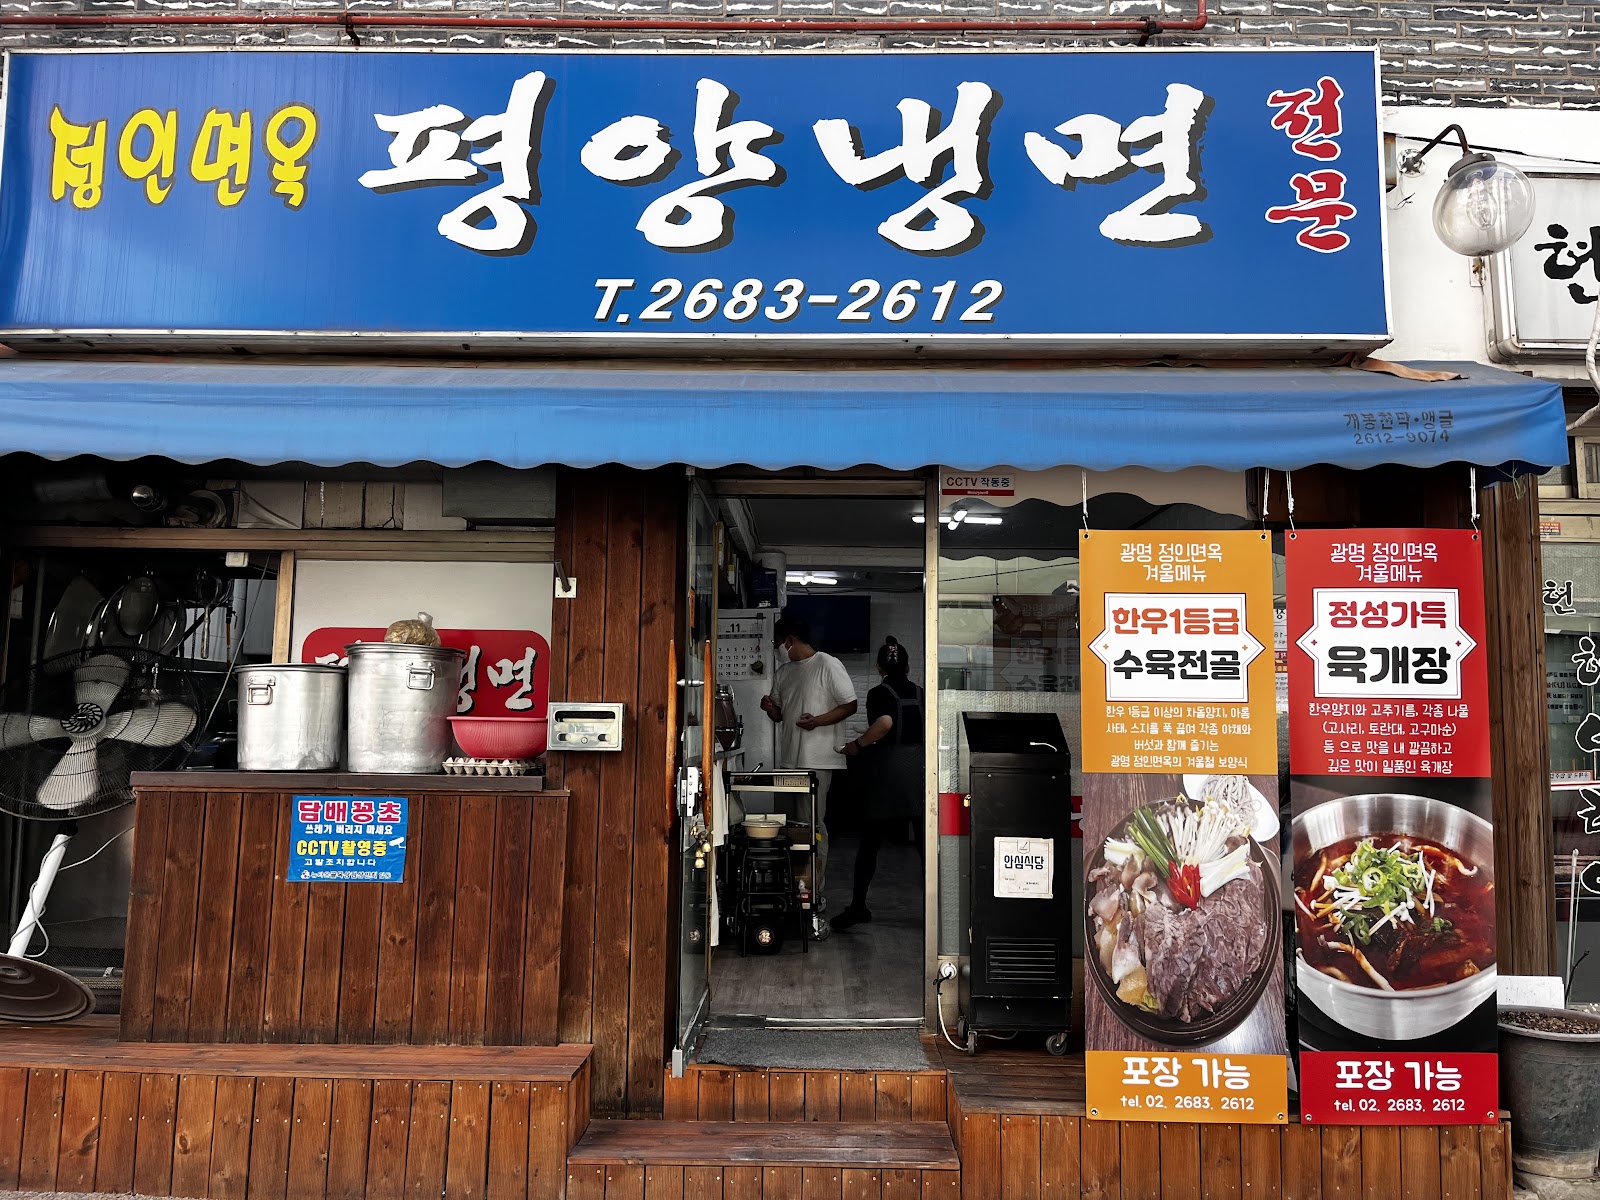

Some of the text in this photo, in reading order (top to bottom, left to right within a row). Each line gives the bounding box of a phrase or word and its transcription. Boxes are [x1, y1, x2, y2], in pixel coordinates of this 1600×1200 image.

[49, 104, 319, 210] 정인면옥
[357, 70, 1206, 252] 평양냉면
[1267, 76, 1356, 253] 전문
[594, 278, 1006, 324] T.2683-2612
[1353, 430, 1451, 445] 2612-9074
[946, 476, 1010, 488] CCTV 작동중
[1120, 543, 1223, 563] 광명 정인면옥
[1330, 542, 1438, 563] 광명 정인면옥
[1142, 563, 1208, 582] 겨울메뉴
[1355, 563, 1423, 583] 겨울메뉴
[1112, 607, 1240, 635] 한우1등급
[1328, 601, 1448, 629] 정성가득
[1113, 649, 1241, 681] 수육전골
[1326, 645, 1451, 685] 육개장
[1106, 705, 1251, 718] 한우 1등급 이상의 차돌양지, 아롱
[1308, 702, 1469, 718] 한우양지와 고추기름, 각종 나물
[1130, 722, 1159, 735] 스지를
[1176, 722, 1196, 735] 끓여
[1199, 722, 1219, 735] 각종
[1221, 722, 1252, 735] 야채와
[1323, 720, 1457, 737] (고사리, 토란대, 고구마순)
[1134, 739, 1219, 752] 버섯과 함께 즐기는
[1323, 740, 1453, 755] 등 으로 맛을 내 깔끔하고
[1110, 755, 1248, 768] 광명 정인면옥의 겨울철 보양식
[1327, 758, 1453, 774] 깊은 맛이 일품인 육개장
[298, 800, 402, 824] 담배꽁초
[305, 824, 393, 835] 쓰레기 버리지 마세요
[1004, 855, 1045, 870] 안심식당
[1121, 1056, 1251, 1090] 포장 가능
[1335, 1060, 1463, 1091] 포장 가능
[1120, 1095, 1255, 1111] tel. 02. 2683. 2612
[1334, 1098, 1466, 1112] tel. 02. 2683. 2612
